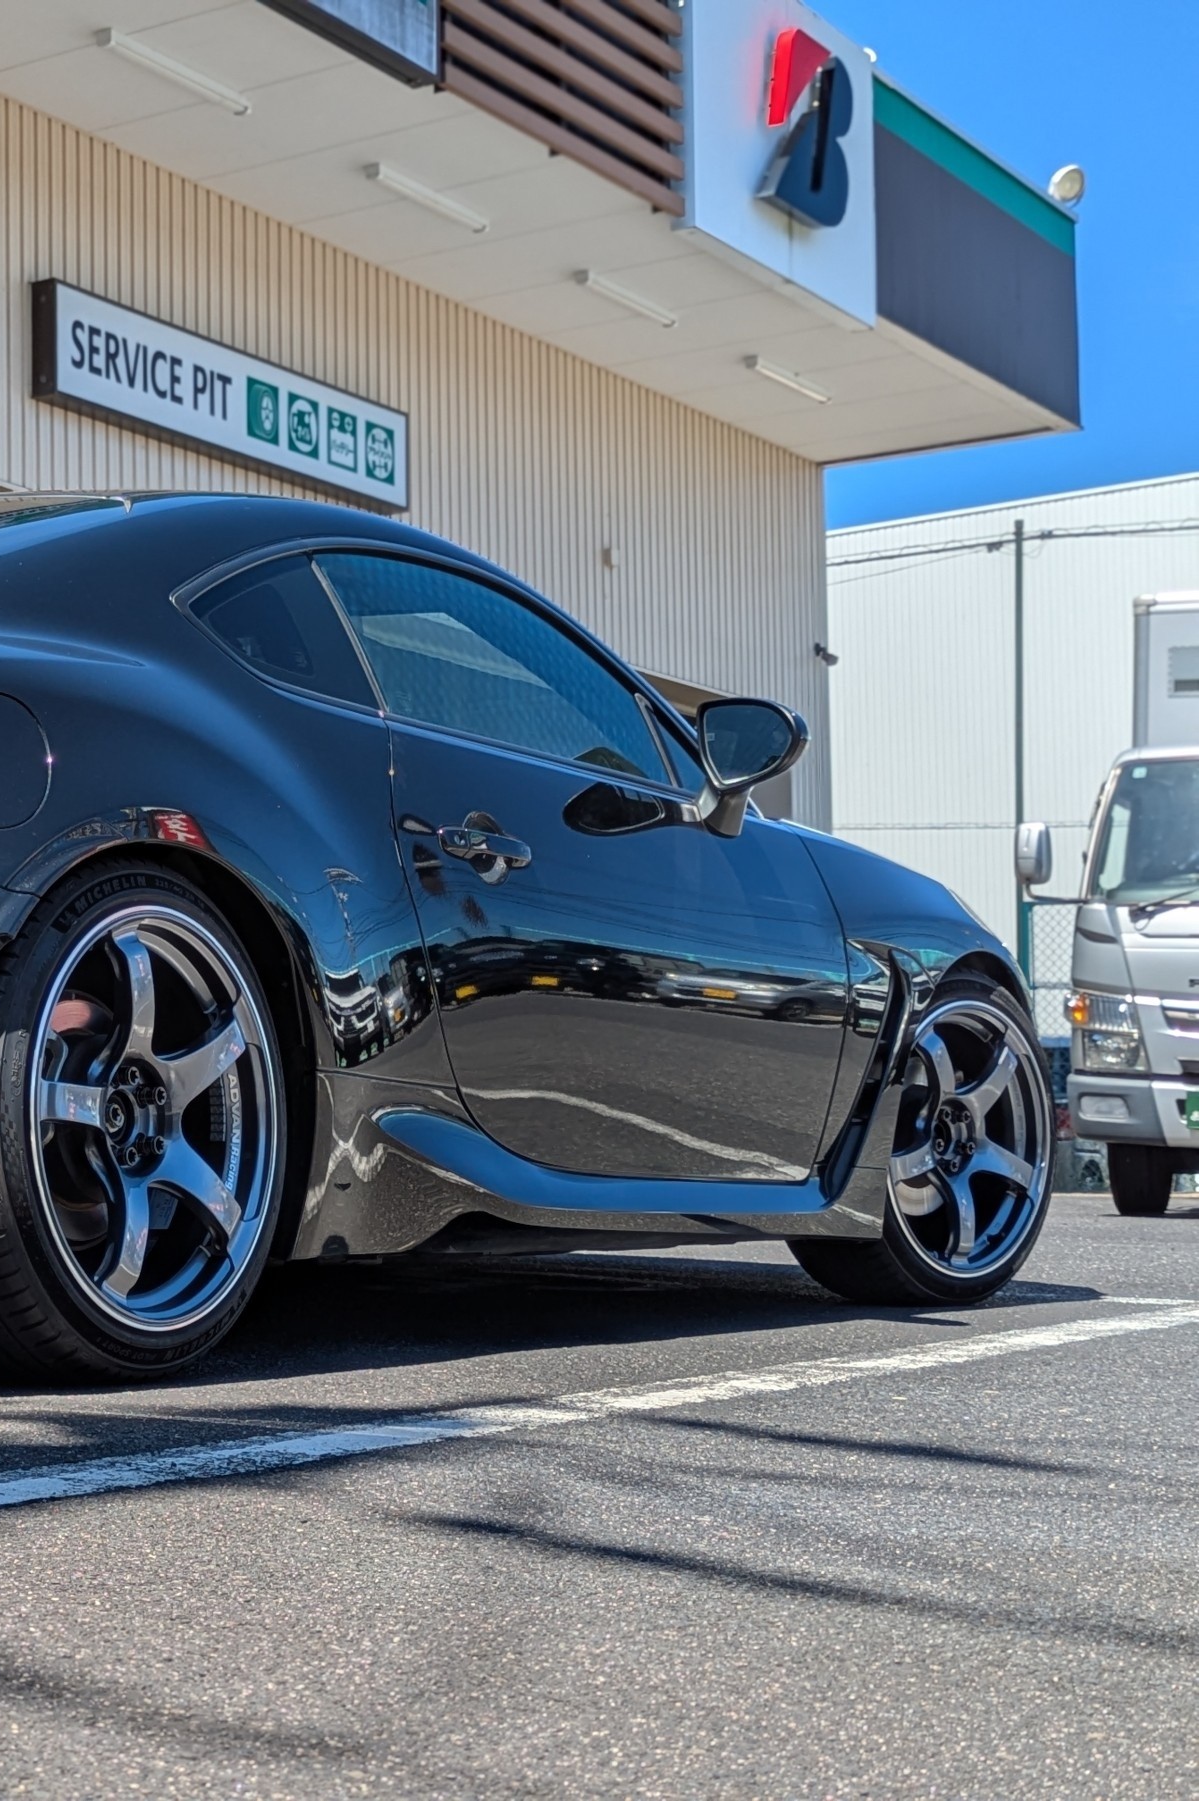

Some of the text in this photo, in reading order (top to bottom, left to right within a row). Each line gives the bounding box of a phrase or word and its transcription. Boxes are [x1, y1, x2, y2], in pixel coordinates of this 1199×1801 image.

[70, 319, 232, 421] SERVICE PIT
[75, 875, 147, 909] MICHELIN
[225, 1074, 242, 1191] ADVAN Racing
